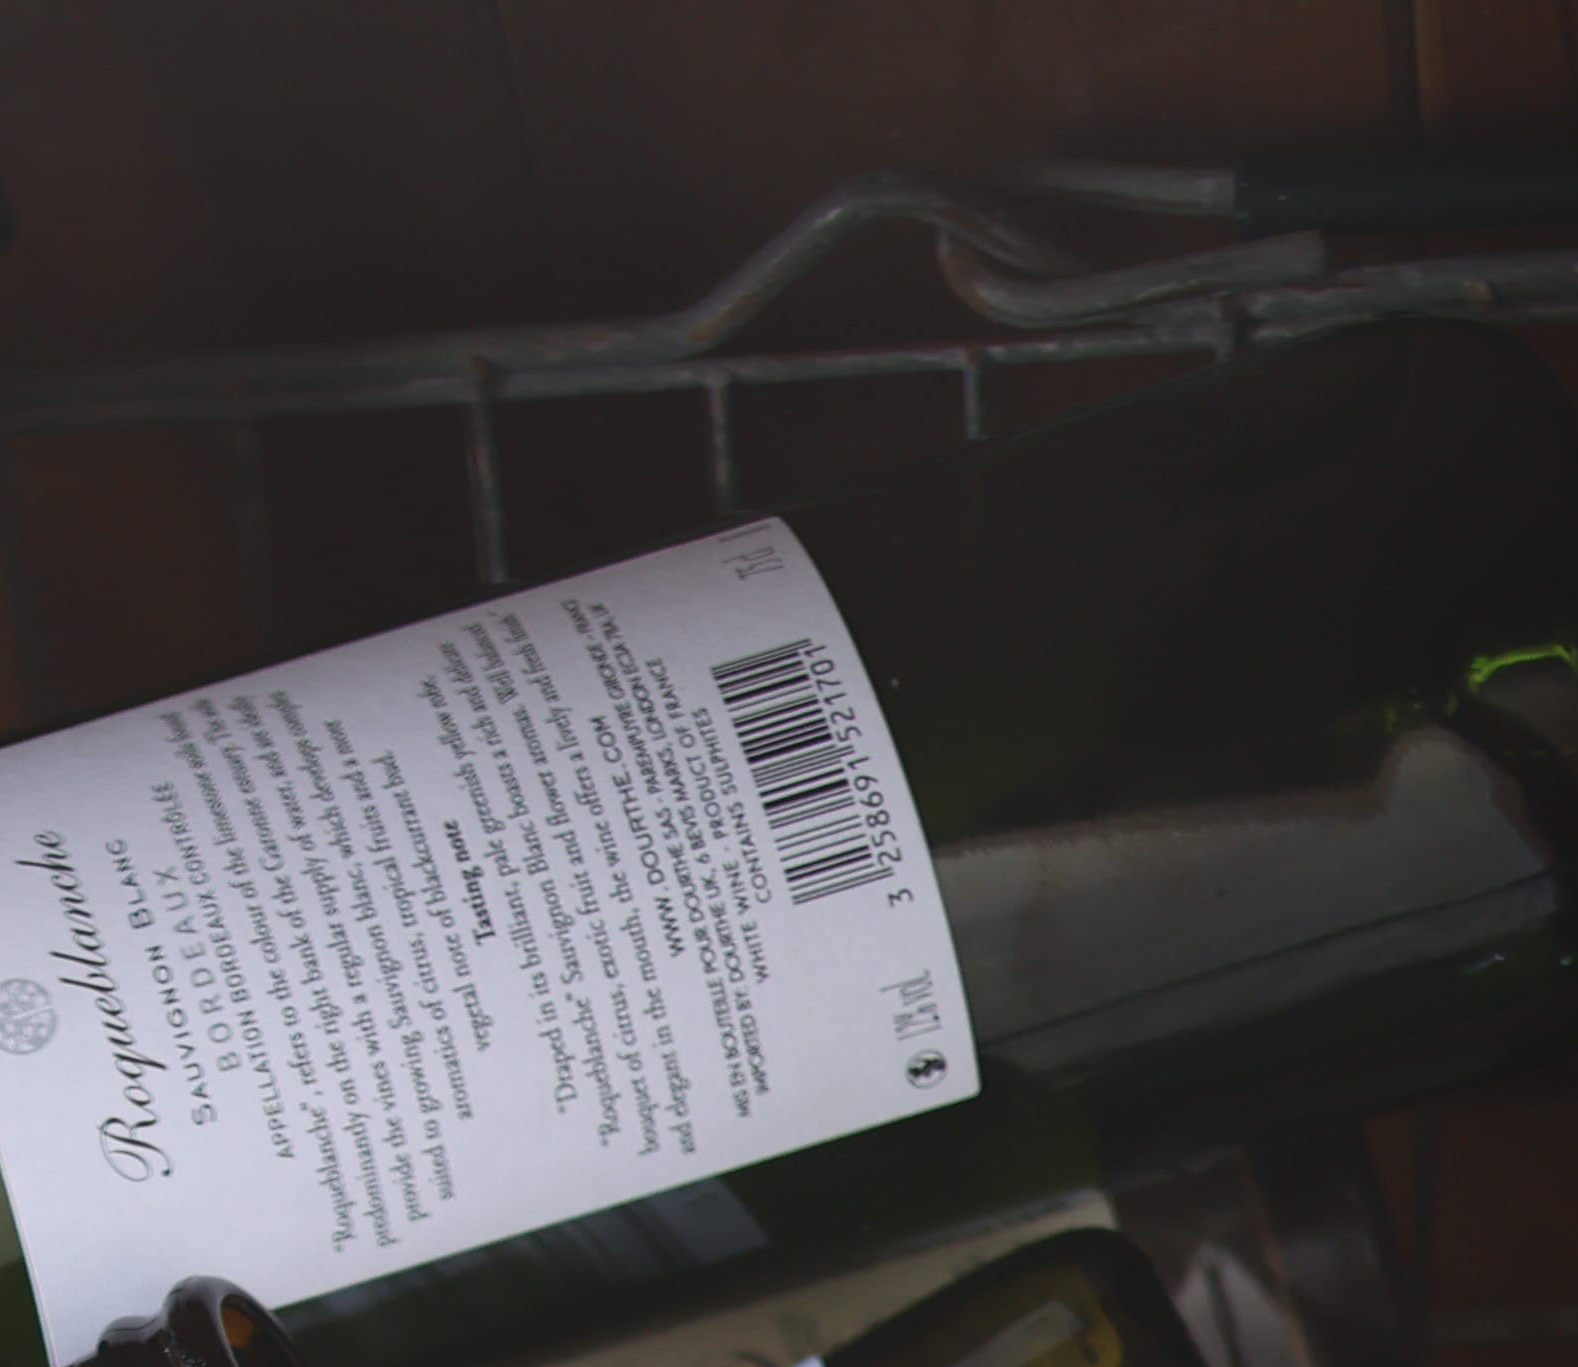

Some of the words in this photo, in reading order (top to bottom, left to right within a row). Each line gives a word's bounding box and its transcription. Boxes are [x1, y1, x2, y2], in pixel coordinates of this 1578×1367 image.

[645, 658, 684, 720] FRANCE
[810, 646, 862, 742] 521701
[436, 711, 475, 759] yellow
[673, 726, 696, 748] OF
[691, 707, 737, 796] SULPHITES
[371, 750, 405, 790] bud.
[453, 762, 503, 834] greenish
[497, 762, 530, 820] boasts
[685, 755, 728, 840] PRODUCT
[152, 783, 210, 885] CONTRÔLÉE
[193, 771, 237, 846] limestone
[244, 798, 284, 872] Garonne
[362, 805, 392, 853] fruits
[852, 757, 903, 866] 258691
[223, 847, 250, 876] the
[393, 790, 446, 905] blackcurrant
[443, 820, 470, 863] note
[483, 839, 518, 877] pale
[519, 821, 549, 876] Blanc
[727, 801, 771, 903] CONTAINS
[105, 839, 154, 929] BLANC
[271, 875, 298, 904] the
[372, 856, 418, 928] tropical
[461, 865, 496, 946] Tasting
[722, 860, 750, 915] WINE
[887, 888, 913, 907] 3
[197, 891, 250, 1003] BORDEAUX
[246, 905, 280, 964] colour
[444, 933, 471, 978] note
[504, 881, 541, 969] brilliant,
[539, 879, 583, 984] Sauvignon
[740, 921, 769, 984] WHITE
[153, 866, 241, 1072] BORDEAUX
[266, 969, 292, 1000] the
[288, 933, 323, 985] bank
[408, 932, 439, 994] citrus,
[528, 971, 550, 997] its
[19, 830, 173, 1183] Roqueblanche
[145, 945, 214, 1125] SAUVIGNON
[308, 987, 340, 1035] right
[451, 983, 491, 1051] vegetal
[536, 1000, 558, 1024] in
[237, 1010, 294, 1158] APPELLATION
[287, 1032, 317, 1085] refers
[325, 1041, 351, 1073] the
[435, 1025, 473, 1120] aromatics
[339, 1078, 359, 1105] on
[343, 1112, 399, 1247] predominantly
